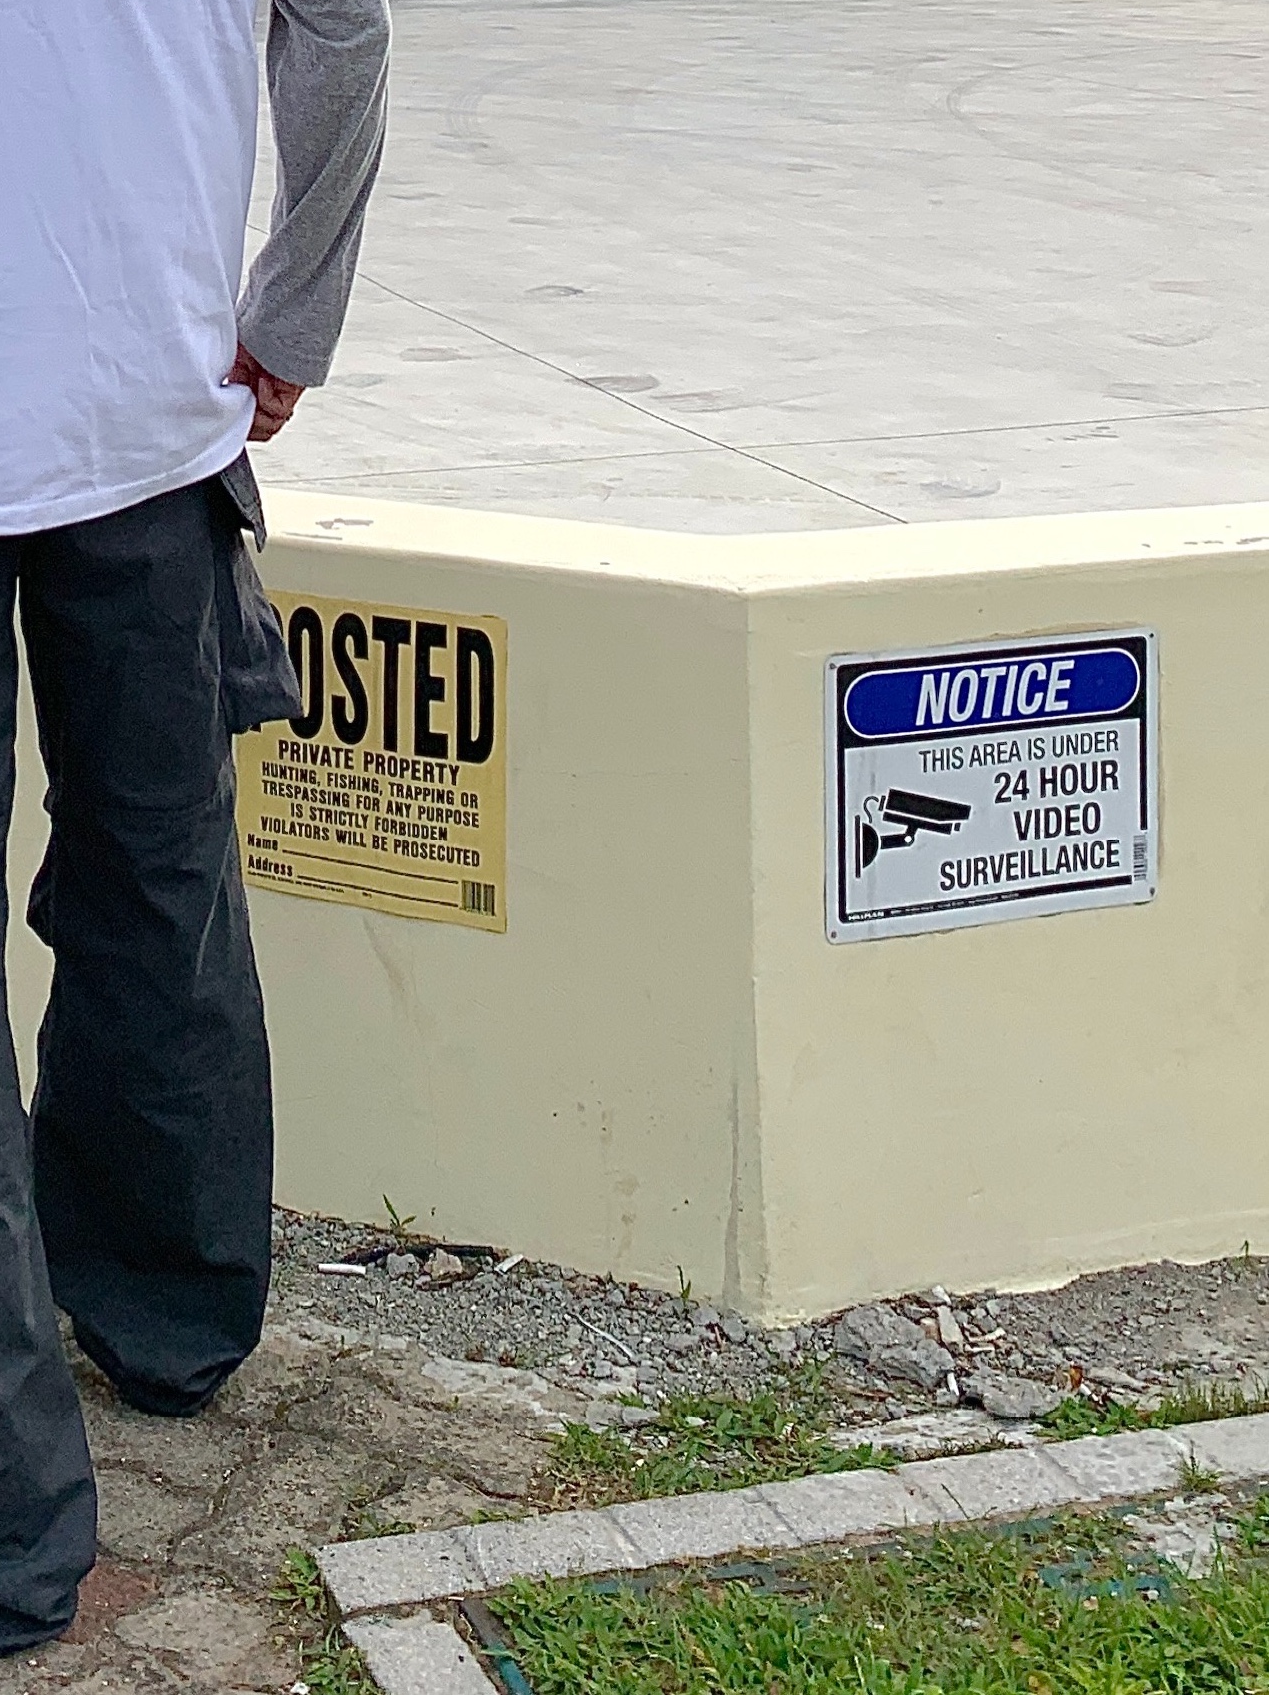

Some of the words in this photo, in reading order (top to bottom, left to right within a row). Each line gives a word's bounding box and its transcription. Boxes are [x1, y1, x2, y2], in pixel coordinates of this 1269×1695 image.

[250, 602, 495, 764] OSTED
[915, 659, 1075, 726] NOTICE
[278, 739, 355, 770] PRIVATE
[363, 751, 461, 786] PROPERTY
[919, 745, 964, 773] THIS
[969, 740, 1022, 767] AREA
[1029, 737, 1046, 760] IS
[1052, 730, 1119, 757] UNDER
[262, 761, 321, 787] HUNTING,
[327, 772, 383, 796] FISHING,
[388, 782, 455, 806] TRAPPING
[460, 792, 479, 809] OR
[262, 780, 350, 807] TRESPASSING
[356, 794, 381, 812] FOR
[386, 801, 412, 818] ANY
[418, 806, 480, 829] PURPOSE
[994, 770, 1030, 804] 24
[1039, 759, 1120, 798] HOUR
[247, 833, 279, 851] Name
[261, 816, 330, 842] VIOLATORS
[336, 830, 366, 848] WILL
[372, 835, 388, 852] BE
[393, 839, 481, 868] PROSECUTED
[290, 802, 304, 818] IS
[309, 806, 369, 830] STRICTLY
[374, 817, 448, 842] FORBIDDEN
[1013, 802, 1102, 841] VIDEO
[247, 854, 294, 877] Address
[940, 839, 1121, 892] SURVEILLANCE
